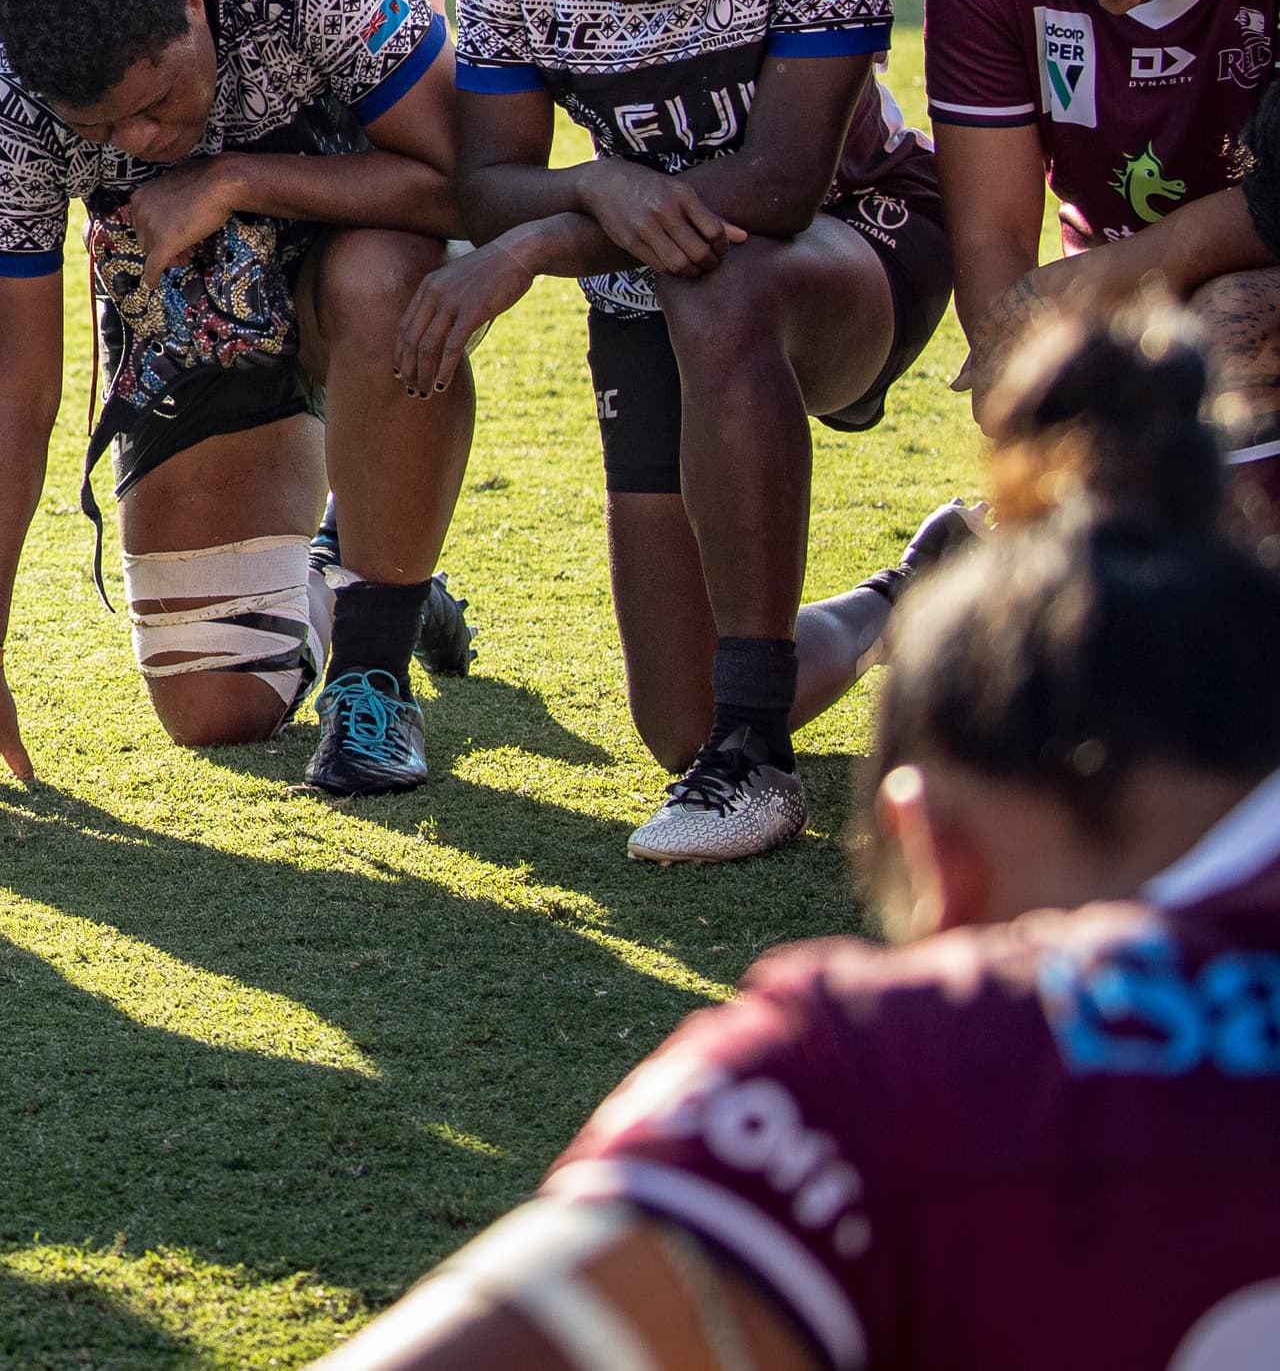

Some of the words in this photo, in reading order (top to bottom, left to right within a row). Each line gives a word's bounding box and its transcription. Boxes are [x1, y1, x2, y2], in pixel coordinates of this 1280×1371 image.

[701, 33, 744, 50] FIJIANA
[1046, 41, 1085, 62] PER
[1128, 76, 1193, 88] DYNASTY
